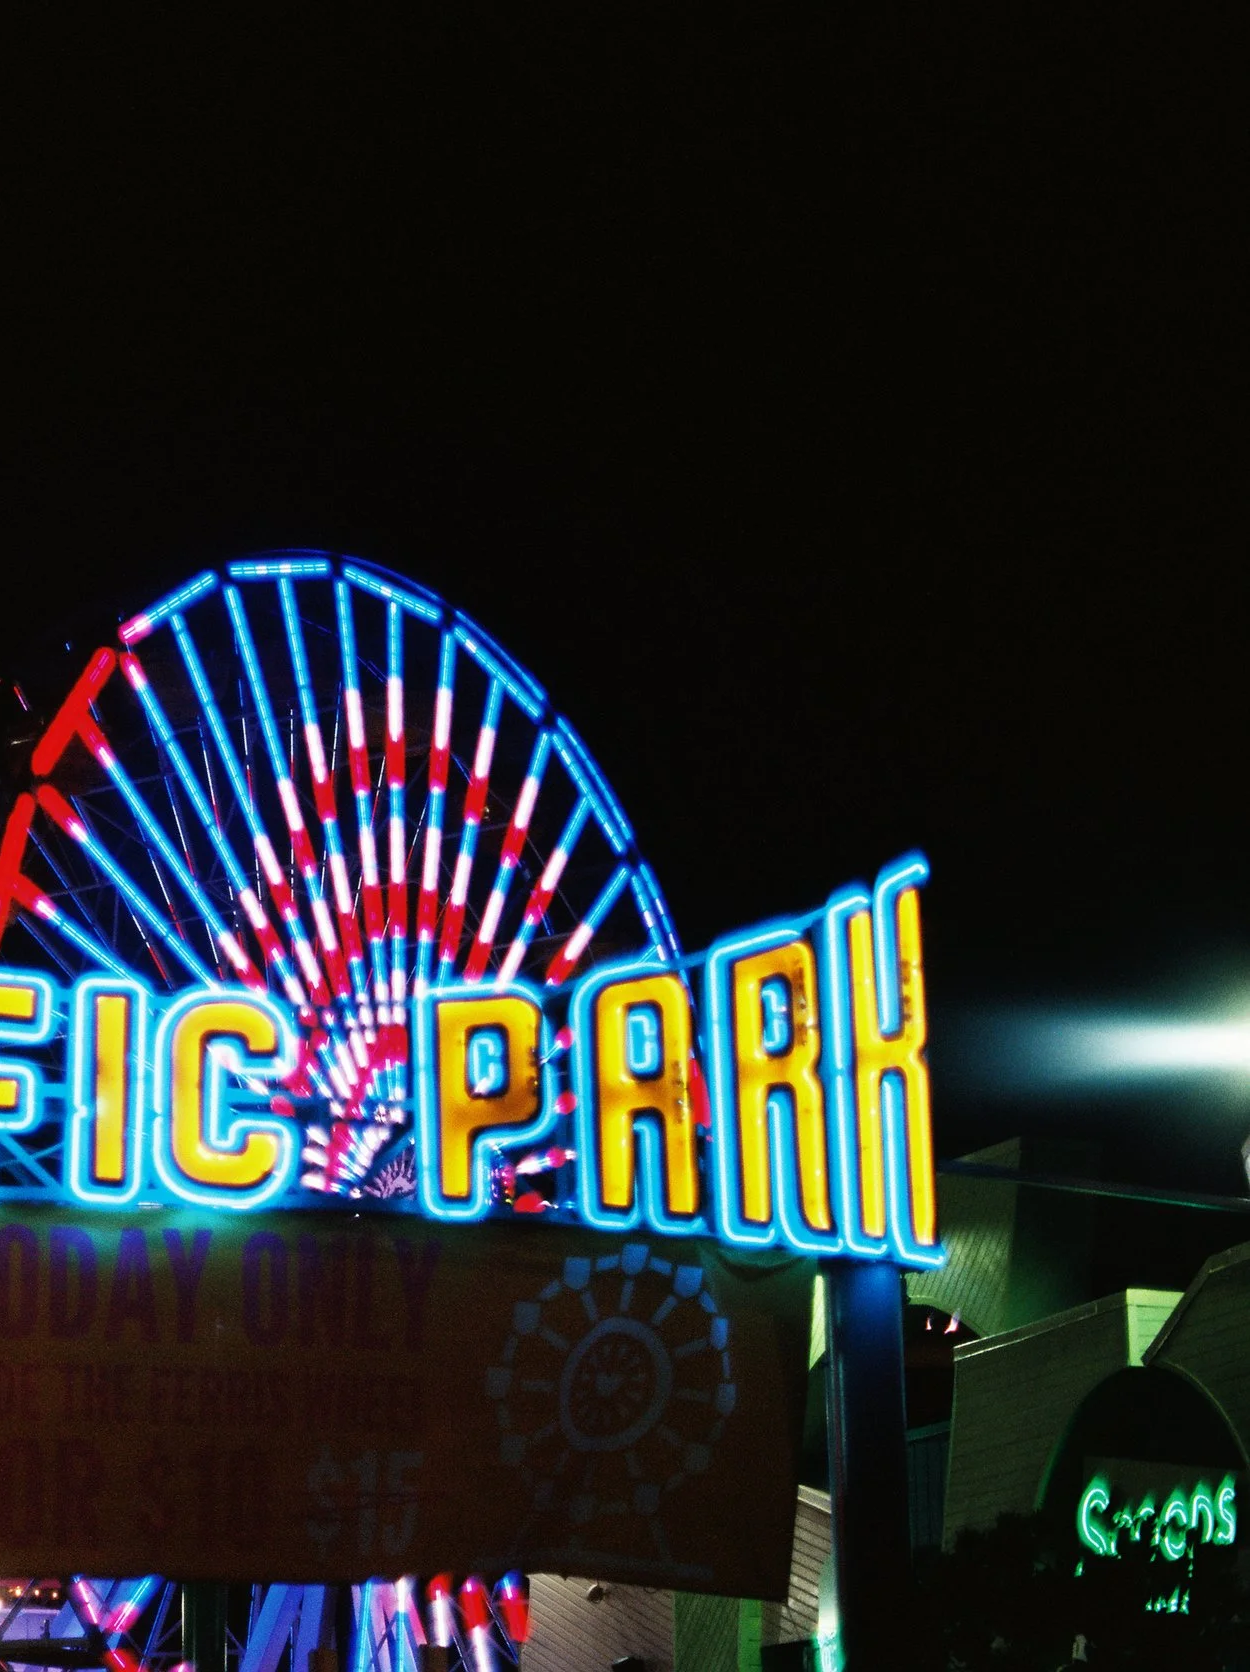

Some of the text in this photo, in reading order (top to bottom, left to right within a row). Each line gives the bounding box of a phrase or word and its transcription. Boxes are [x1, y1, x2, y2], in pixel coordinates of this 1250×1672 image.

[414, 851, 947, 1268] PARK
[241, 1230, 442, 1353] ONLY
[54, 1363, 133, 1426] THE
[306, 1443, 425, 1560] $15
